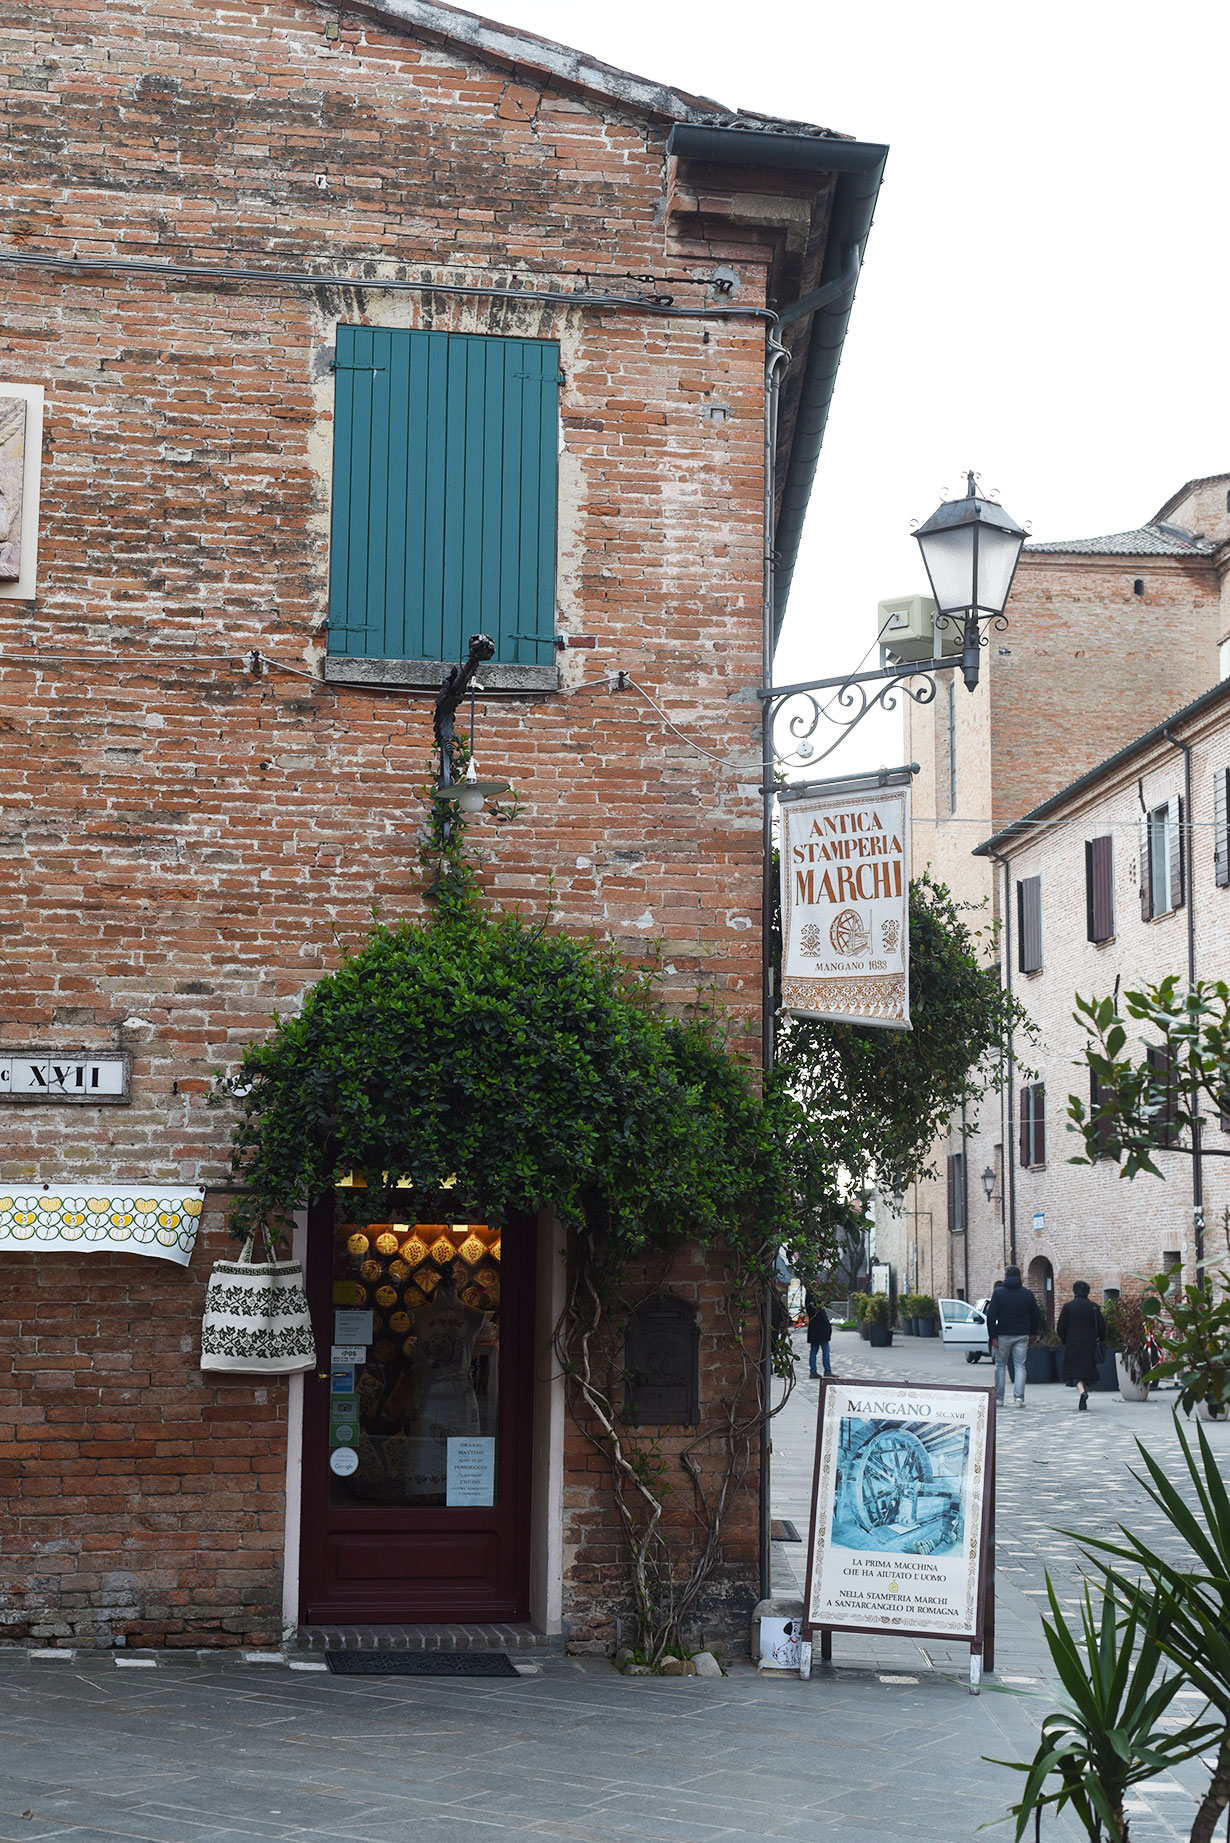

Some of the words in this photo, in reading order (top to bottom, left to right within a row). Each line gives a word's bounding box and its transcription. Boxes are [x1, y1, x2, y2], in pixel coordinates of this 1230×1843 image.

[810, 811, 883, 837] ANTICA
[793, 835, 902, 864] STAMPERIA
[795, 861, 902, 905] MARCHI
[815, 962, 864, 971] MANGANO
[29, 1066, 100, 1088] XVII
[847, 1400, 931, 1417] MANGANO
[843, 1568, 859, 1576] CHE
[862, 1569, 874, 1577] HA
[877, 1571, 912, 1579] AIUTATO
[865, 1560, 891, 1568] PRIMA
[894, 1562, 938, 1571] MACCHINA
[839, 1590, 864, 1598] NELLA
[866, 1592, 911, 1602] STAMPERIA
[914, 1596, 947, 1605] MARCHI
[835, 1600, 904, 1611] SANTARCANGELO
[917, 1606, 959, 1616] ROMAGNA
